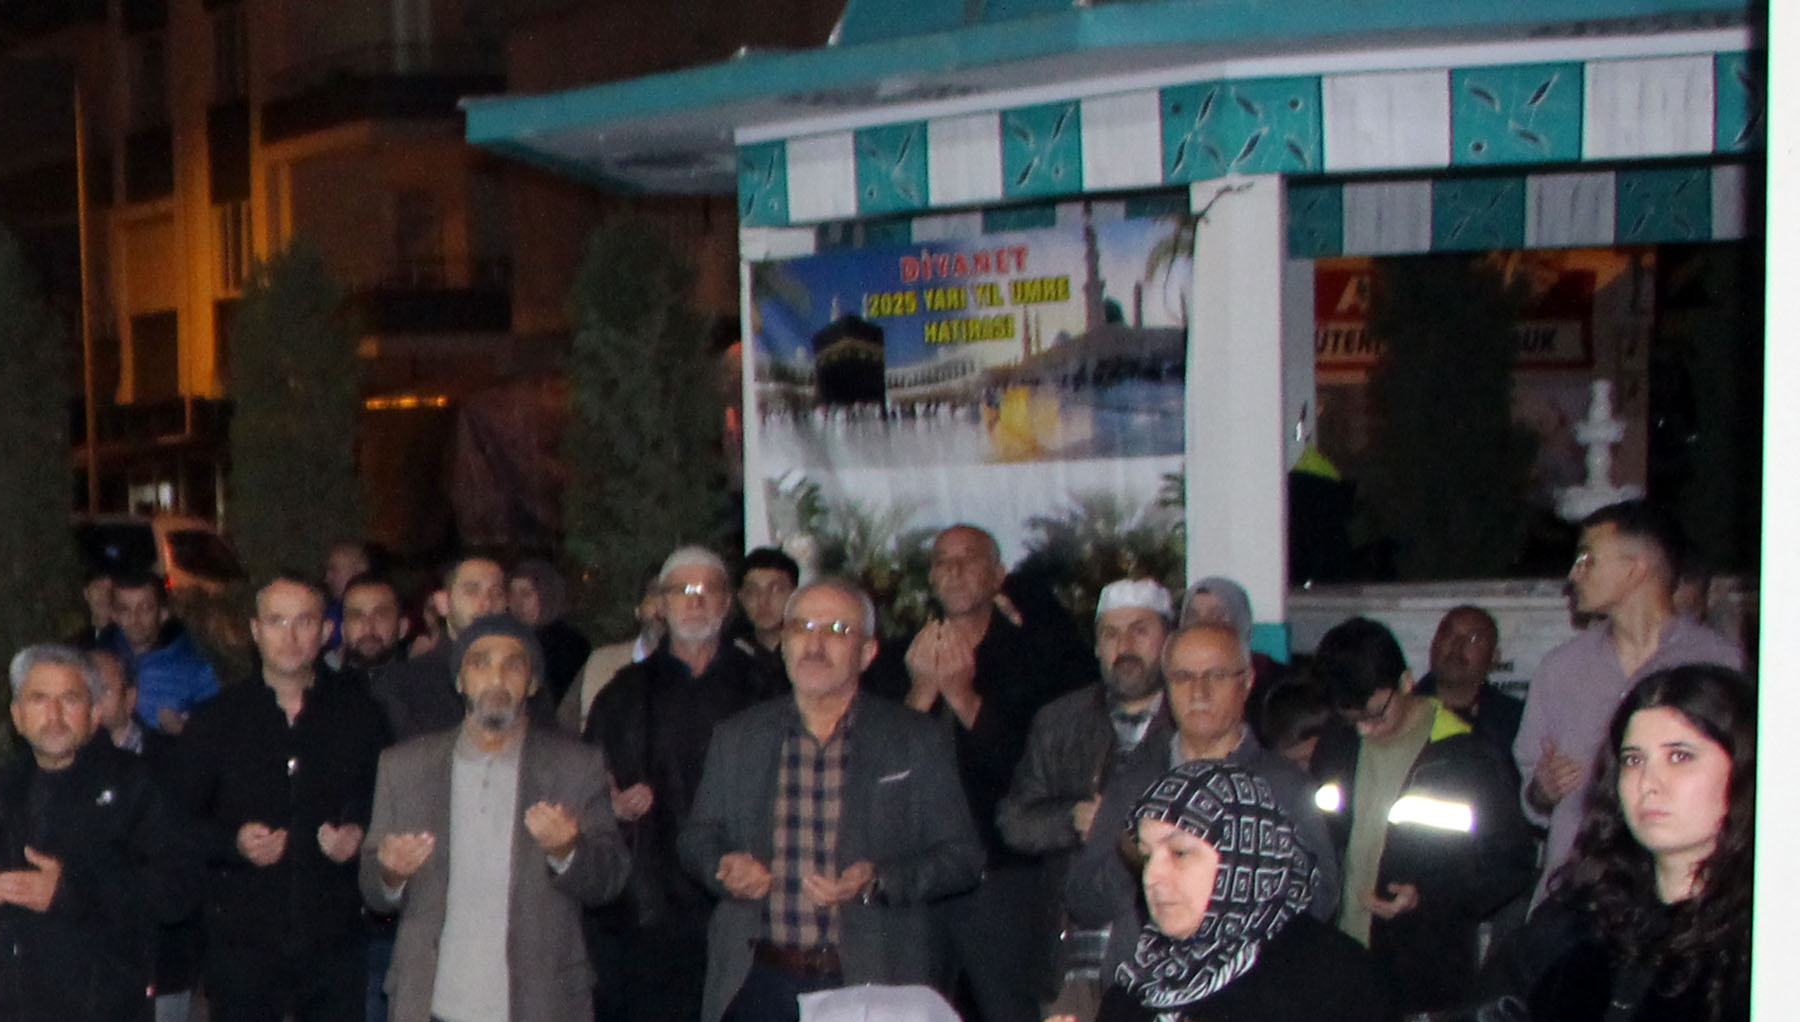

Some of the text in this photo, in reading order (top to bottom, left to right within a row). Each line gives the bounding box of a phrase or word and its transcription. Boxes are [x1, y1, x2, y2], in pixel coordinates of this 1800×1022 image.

[901, 248, 1027, 281] DİYANET
[868, 291, 917, 317] 2025
[924, 287, 967, 310] YARI
[975, 283, 1003, 307] YIL
[925, 314, 1015, 342] HATIRASI
